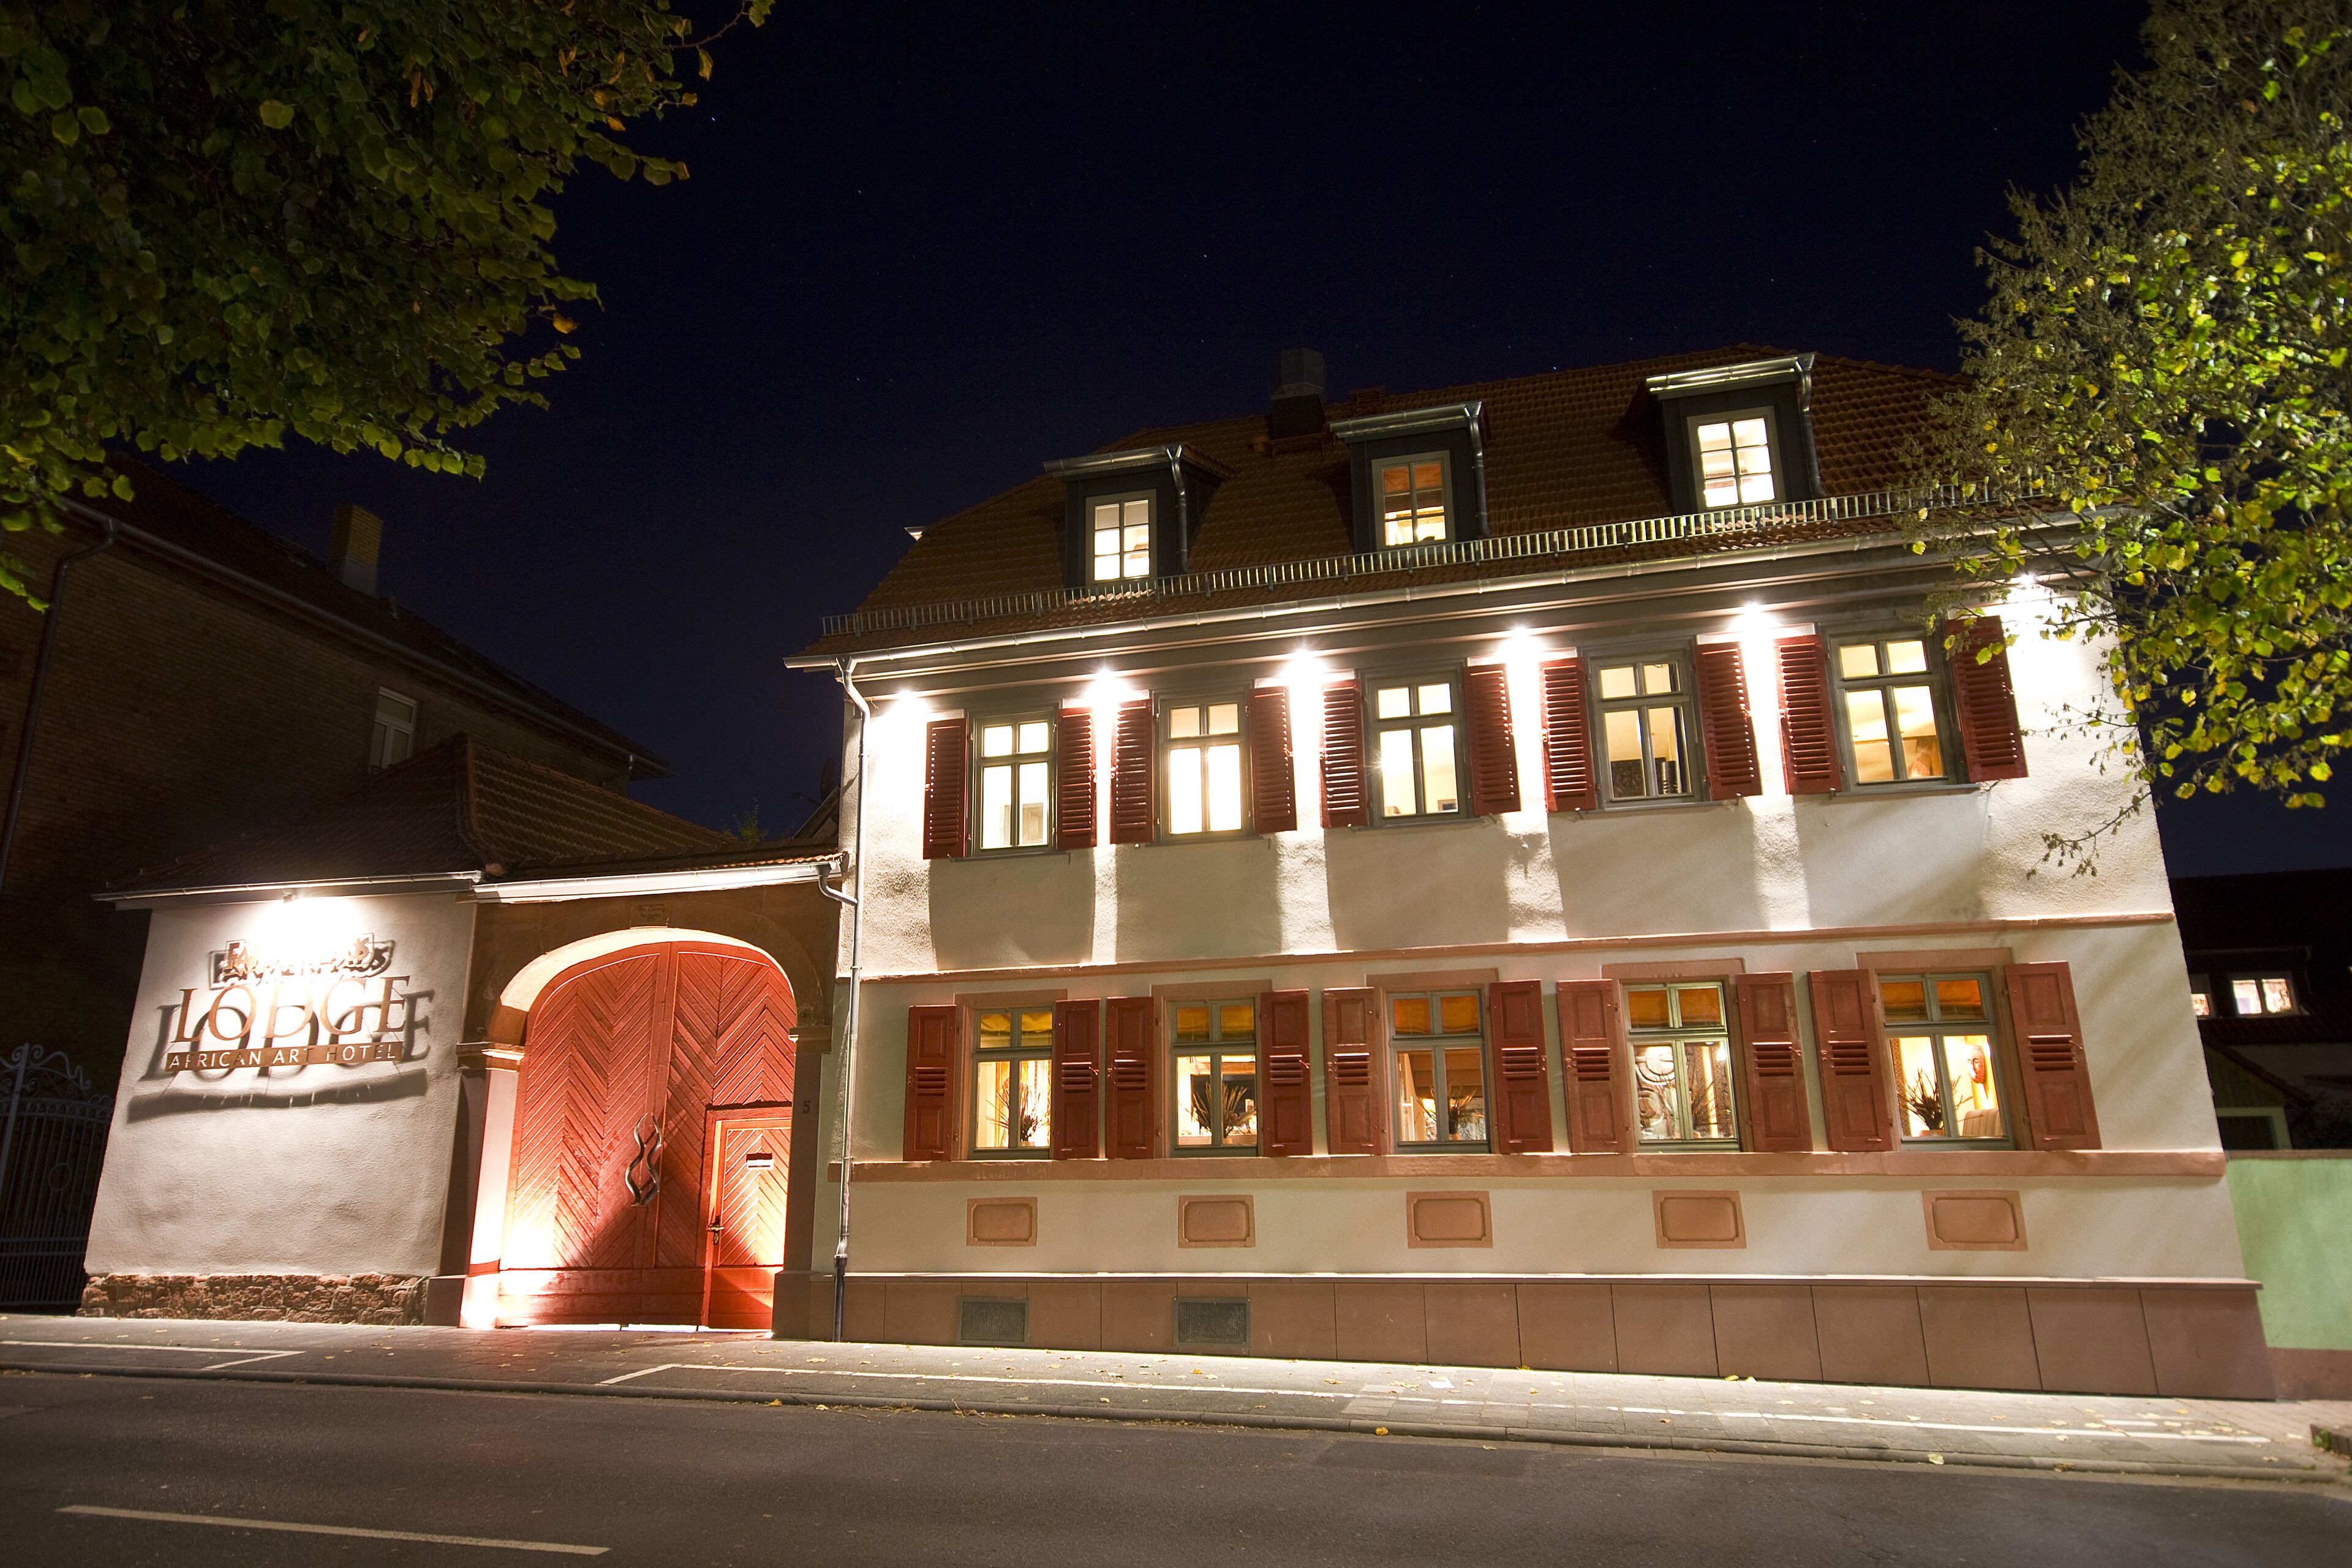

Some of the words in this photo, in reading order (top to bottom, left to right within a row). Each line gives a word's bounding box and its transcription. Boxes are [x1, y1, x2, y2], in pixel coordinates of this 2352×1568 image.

[174, 975, 410, 1043] LODGE
[168, 1050, 262, 1069] AFRICAN
[272, 1048, 314, 1064] ART
[325, 1044, 396, 1061] HOTEL
[802, 1100, 810, 1114] 5
